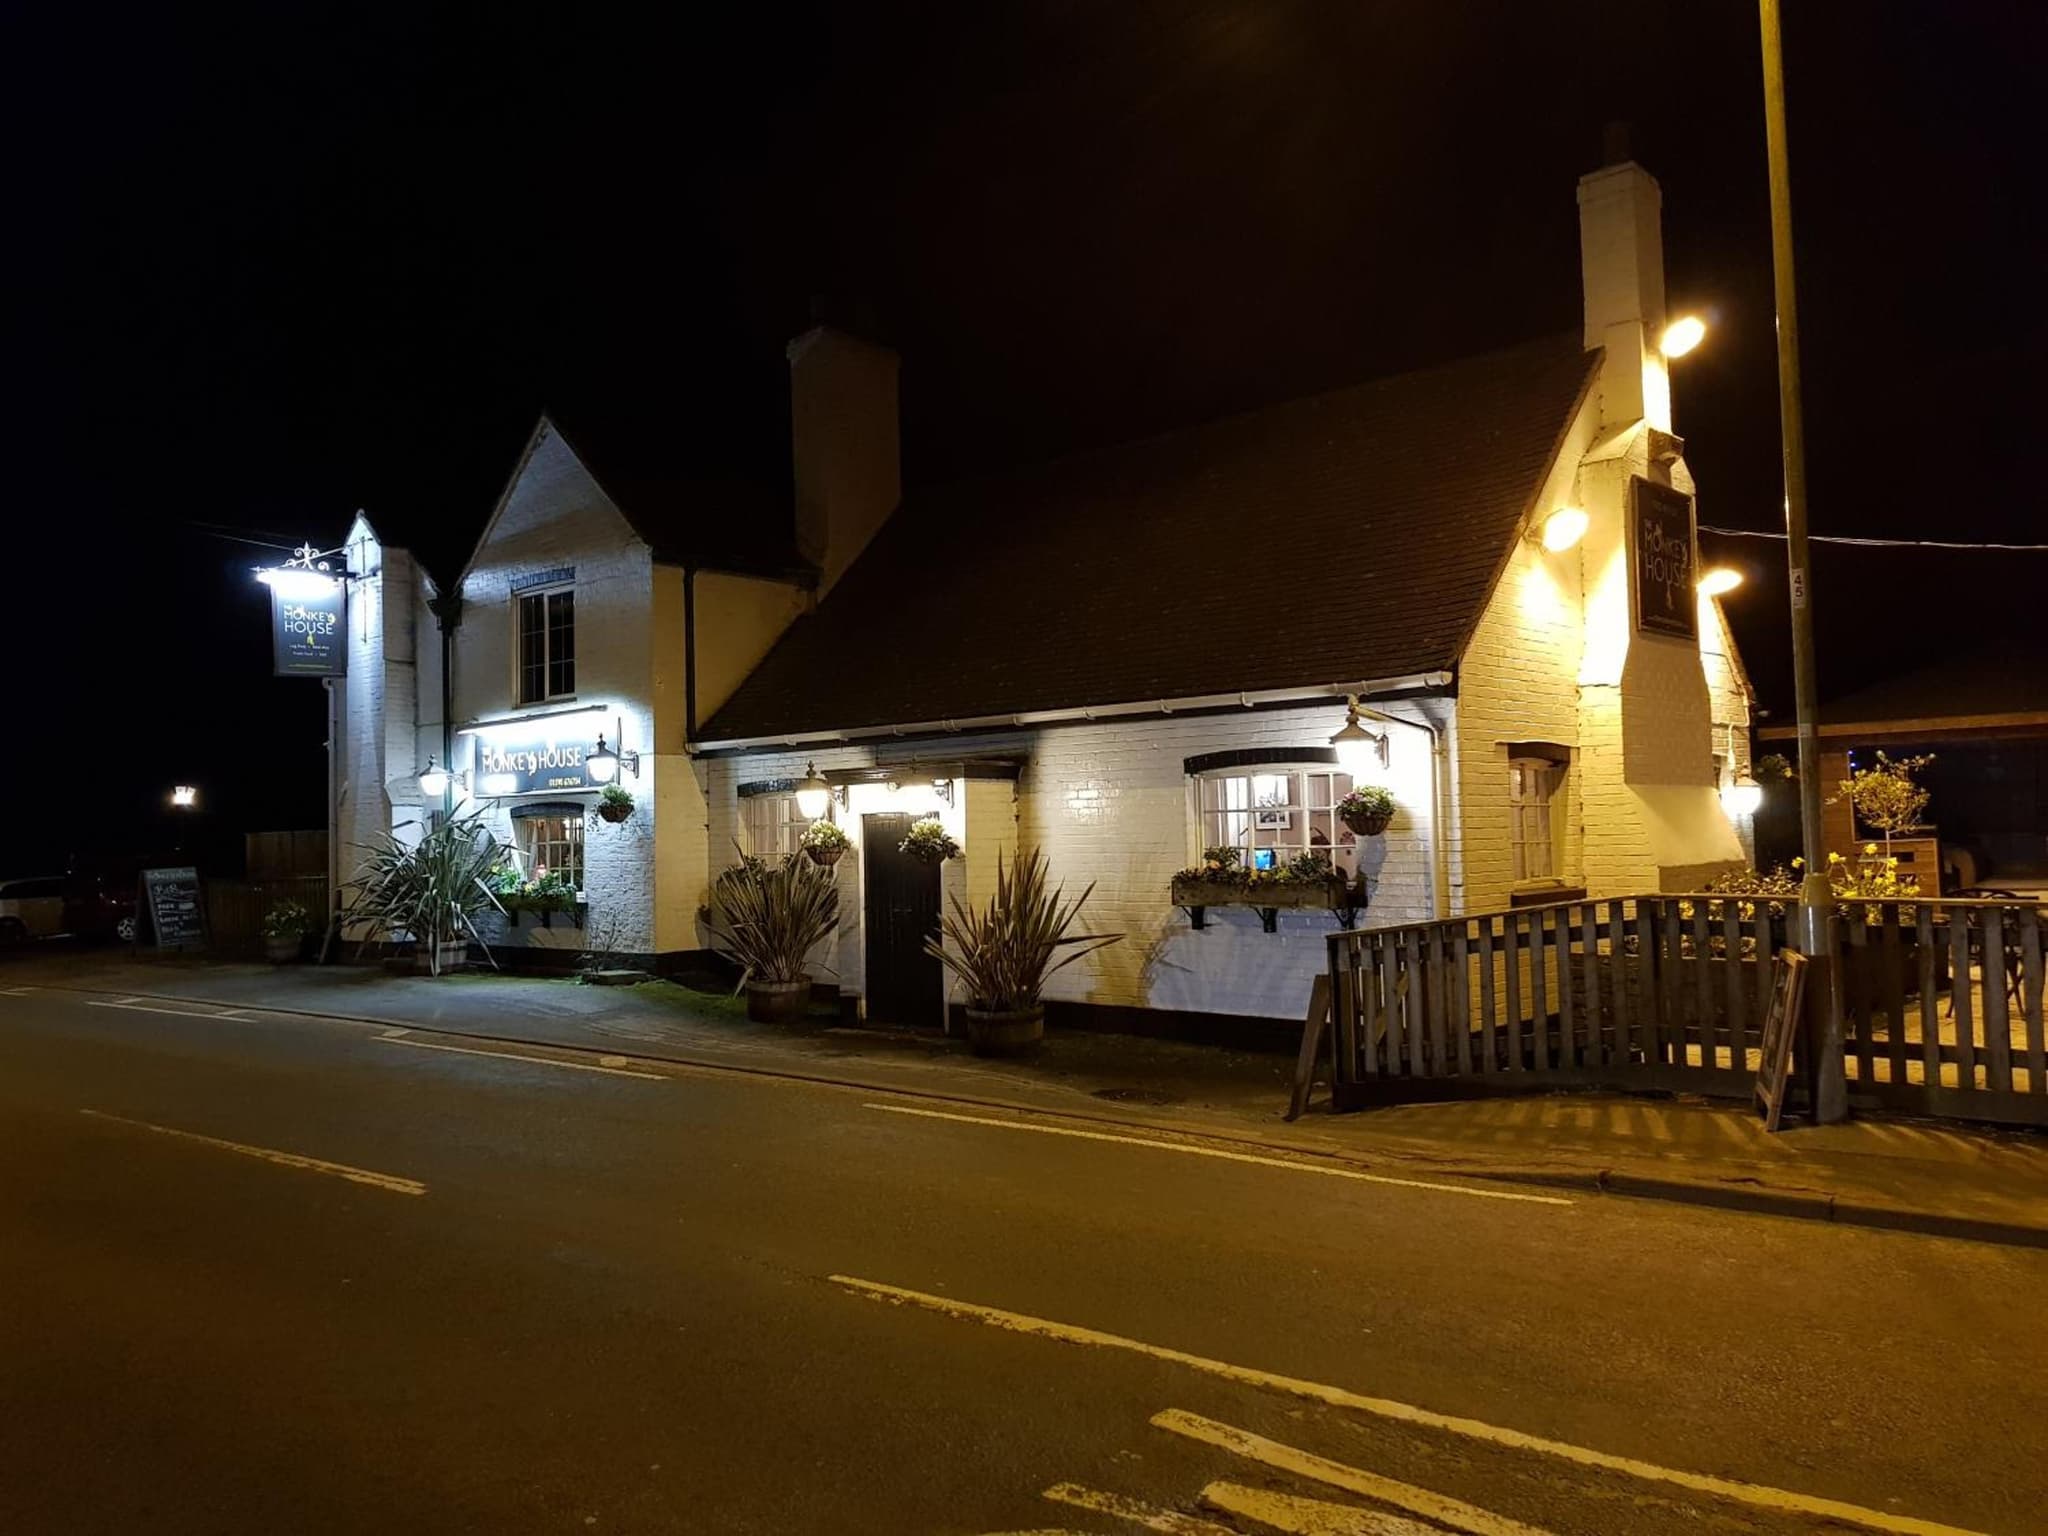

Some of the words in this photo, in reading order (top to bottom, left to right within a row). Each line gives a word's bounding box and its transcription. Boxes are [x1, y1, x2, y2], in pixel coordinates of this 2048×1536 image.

[1644, 527, 1687, 561] MOEY
[1644, 554, 1687, 590] HOUSE
[284, 609, 333, 622] MONKEY
[284, 620, 334, 635] HOUSE
[482, 750, 535, 774] MONKEY
[538, 747, 582, 769] HOUSE
